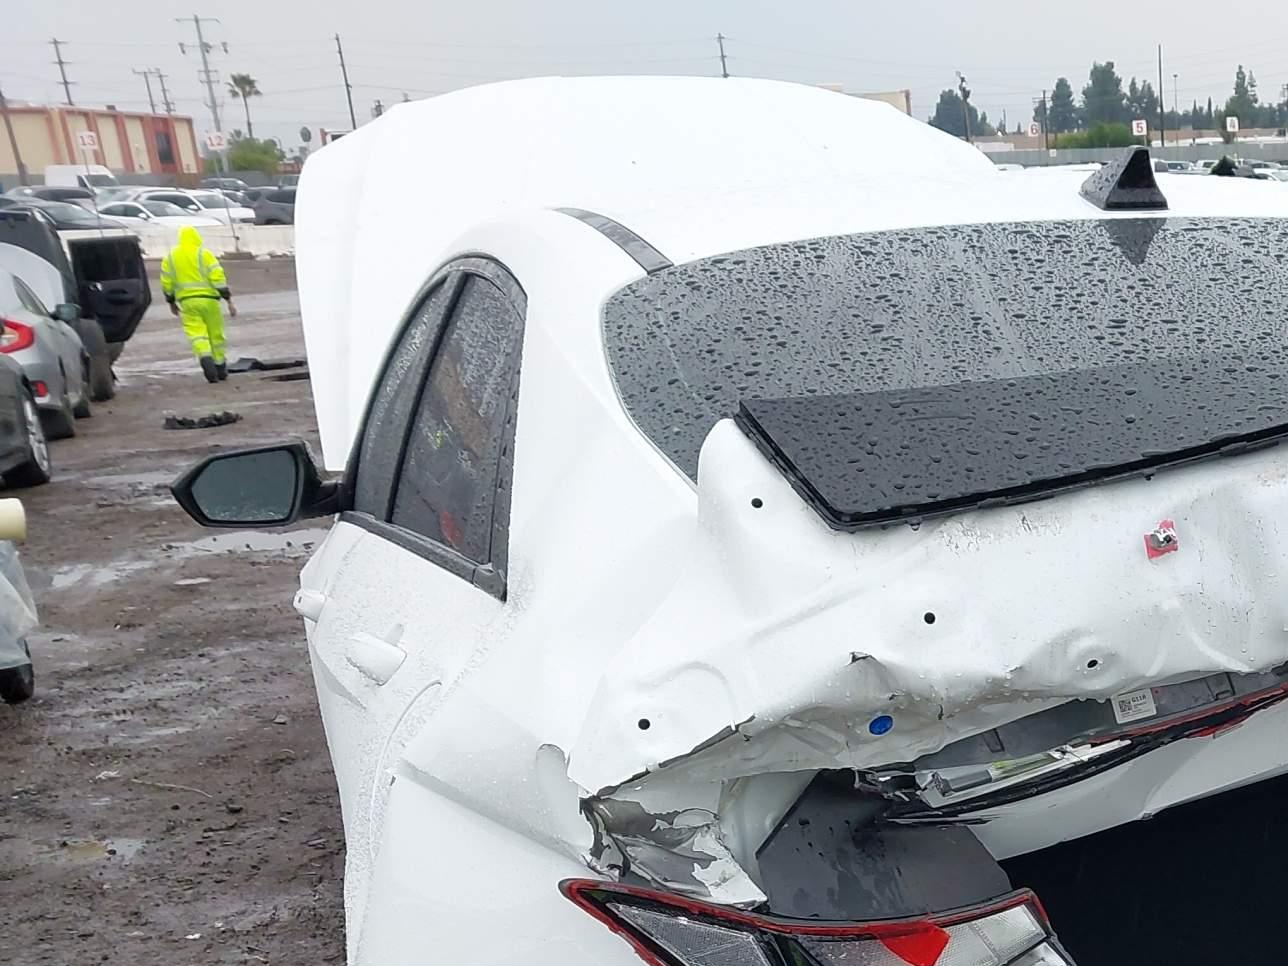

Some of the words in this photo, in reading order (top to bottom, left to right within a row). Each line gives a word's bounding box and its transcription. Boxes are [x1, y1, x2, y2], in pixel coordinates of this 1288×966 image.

[1030, 123, 1038, 135] 6
[1136, 121, 1144, 134] 5
[80, 135, 97, 146] 13
[208, 135, 224, 147] 12
